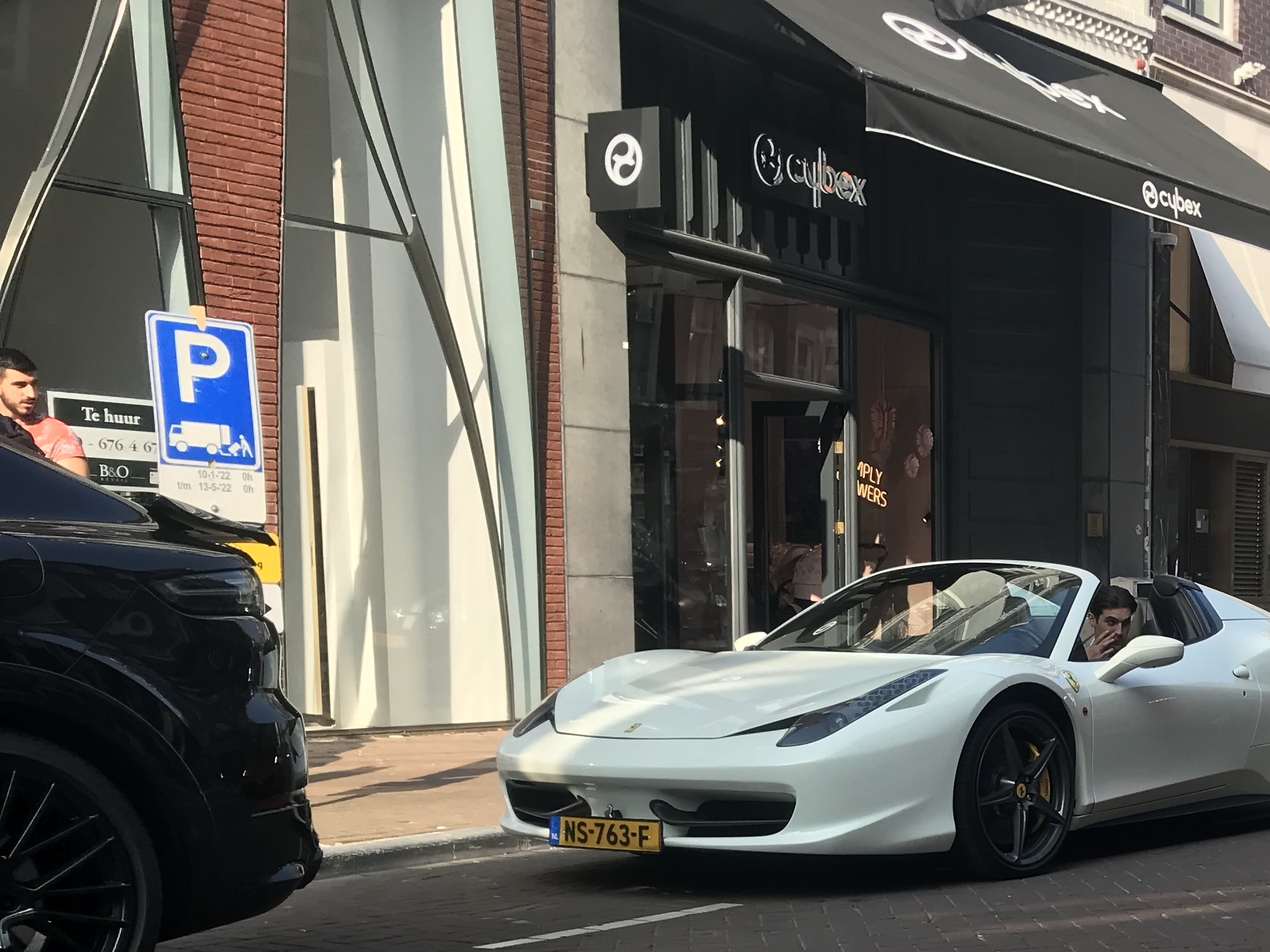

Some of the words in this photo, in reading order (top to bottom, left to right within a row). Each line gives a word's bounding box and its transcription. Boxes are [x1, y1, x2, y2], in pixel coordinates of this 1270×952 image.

[786, 146, 868, 209] cybex
[1159, 186, 1203, 220] cybex
[174, 329, 231, 403] P
[81, 406, 101, 422] Te
[104, 408, 142, 426] huur
[98, 437, 124, 451] 676
[129, 438, 138, 452] 4
[99, 463, 129, 478] B&O
[242, 472, 253, 482] 0h
[177, 481, 192, 491] t/m
[243, 484, 254, 494] 0h
[551, 832, 559, 840] NL
[564, 820, 650, 848] NS-763-F
